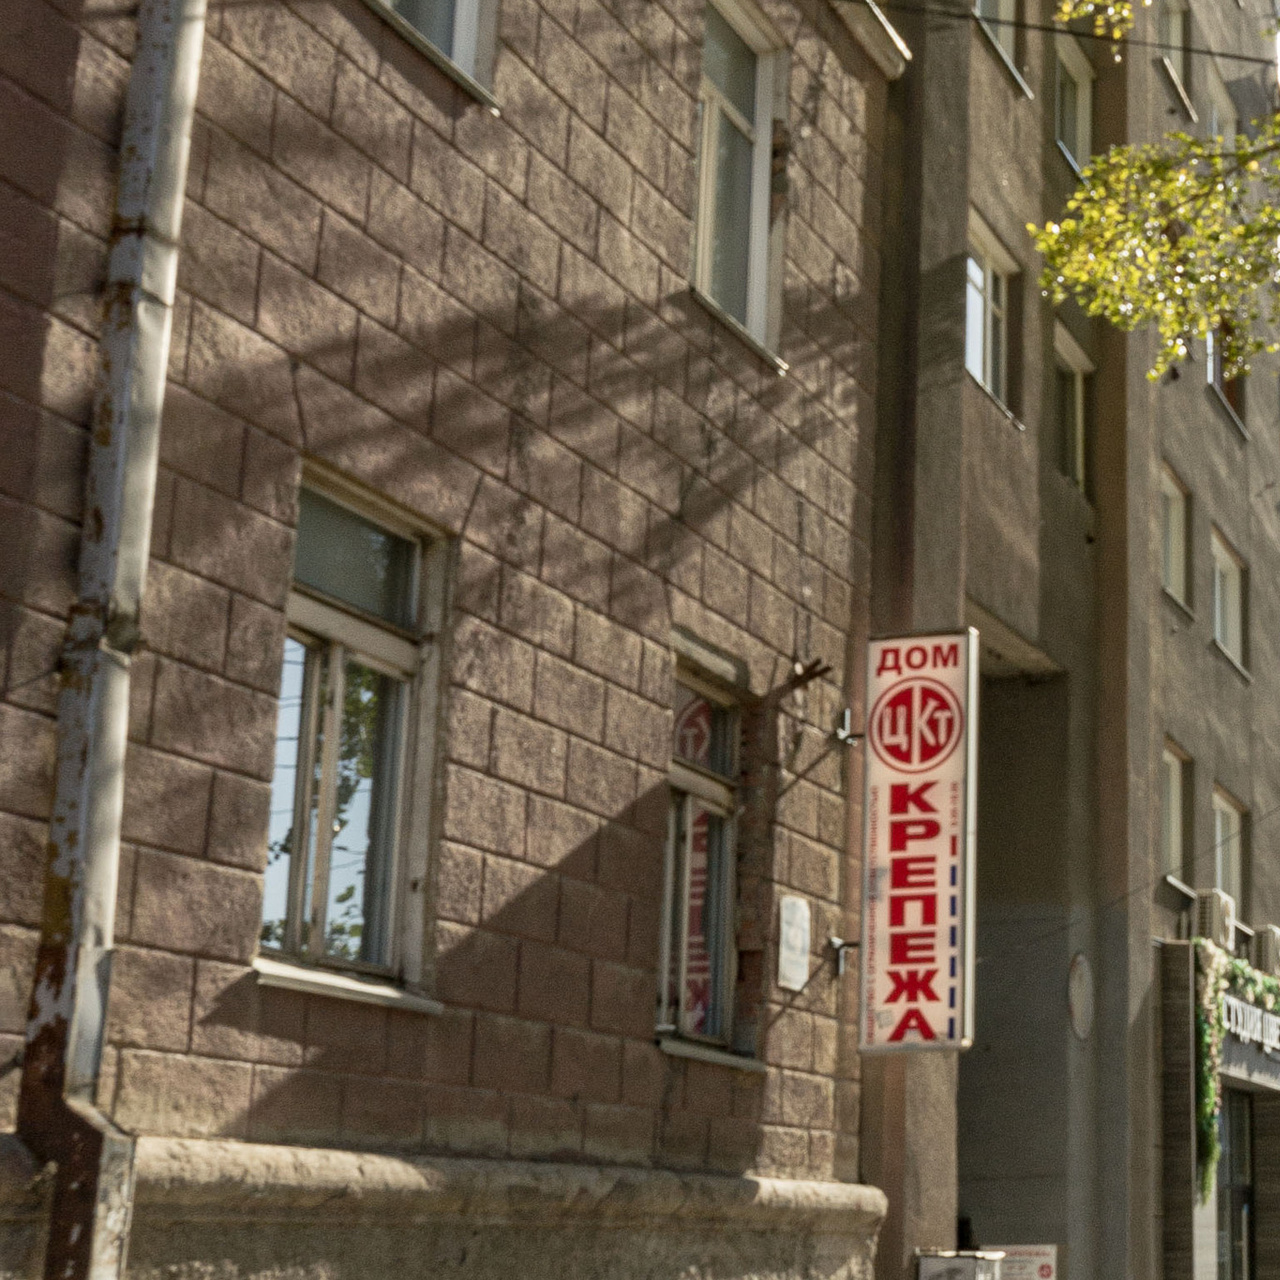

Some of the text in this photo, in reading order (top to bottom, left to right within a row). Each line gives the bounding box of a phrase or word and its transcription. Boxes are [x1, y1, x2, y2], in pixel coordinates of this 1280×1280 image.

[876, 643, 959, 676] ДОМ
[880, 690, 954, 758] ЦКТ
[884, 781, 941, 1042] КРЕПЕЖА
